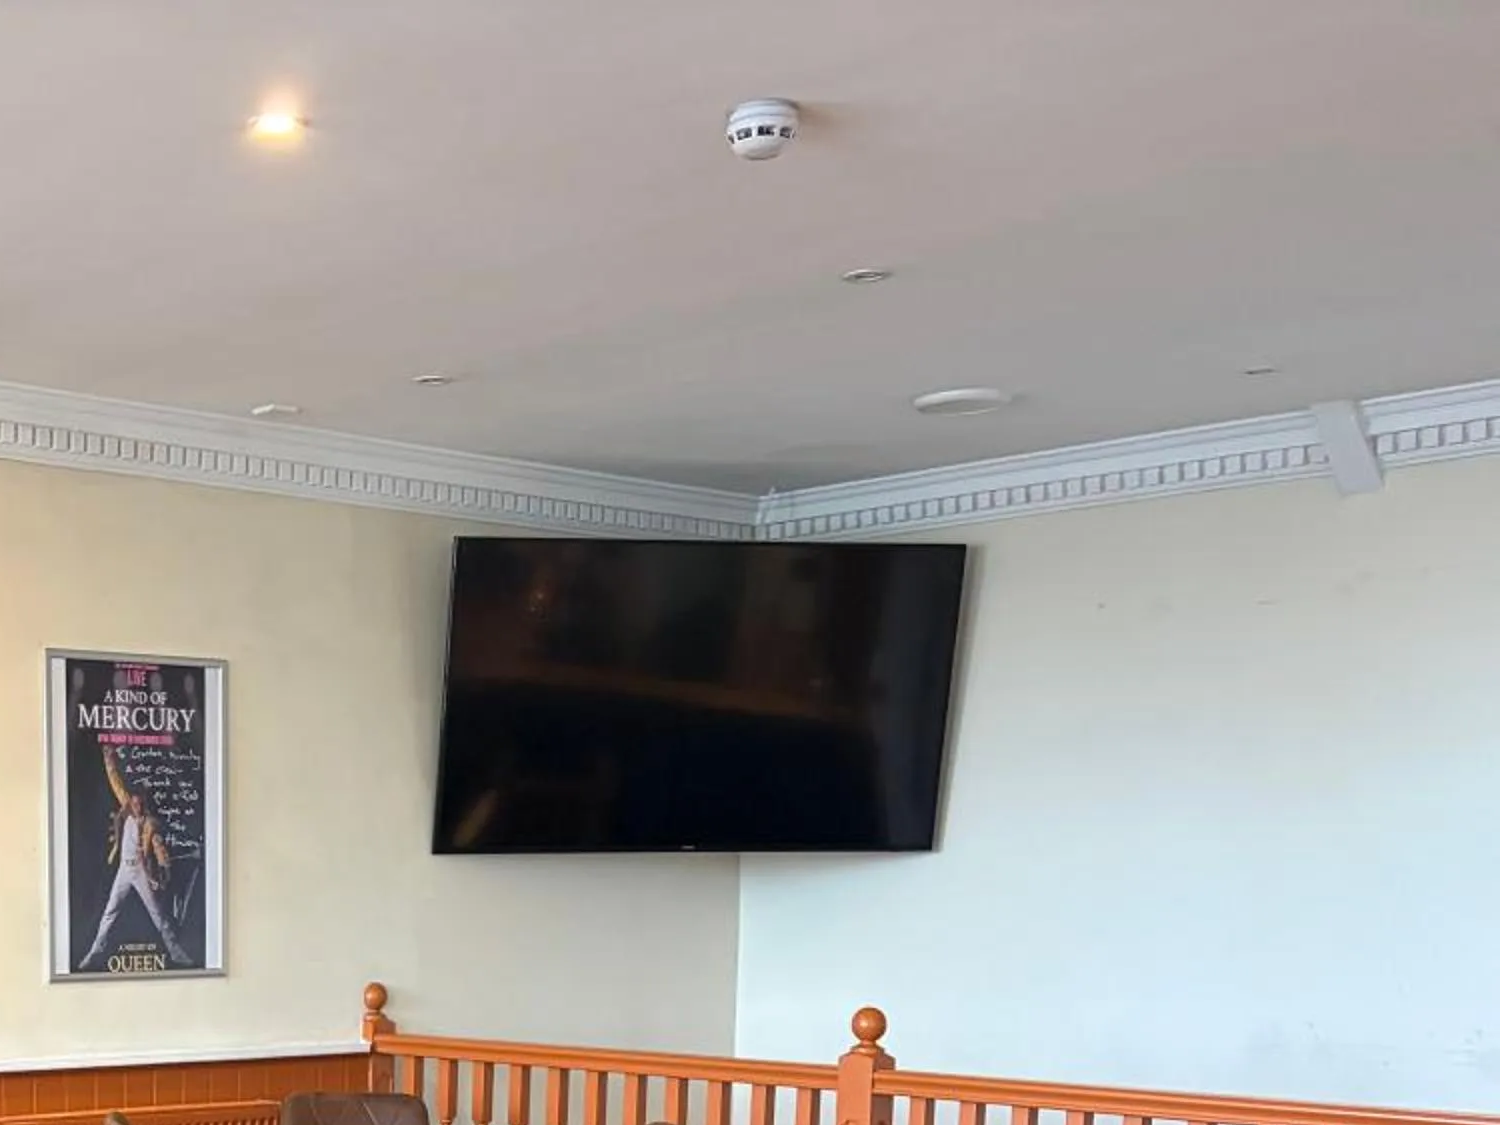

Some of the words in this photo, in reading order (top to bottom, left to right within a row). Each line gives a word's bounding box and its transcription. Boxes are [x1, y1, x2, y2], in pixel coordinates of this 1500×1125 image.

[115, 689, 148, 704] KIND
[149, 690, 169, 705] OF
[77, 703, 196, 732] MERCURY
[107, 953, 165, 973] QUEEN
